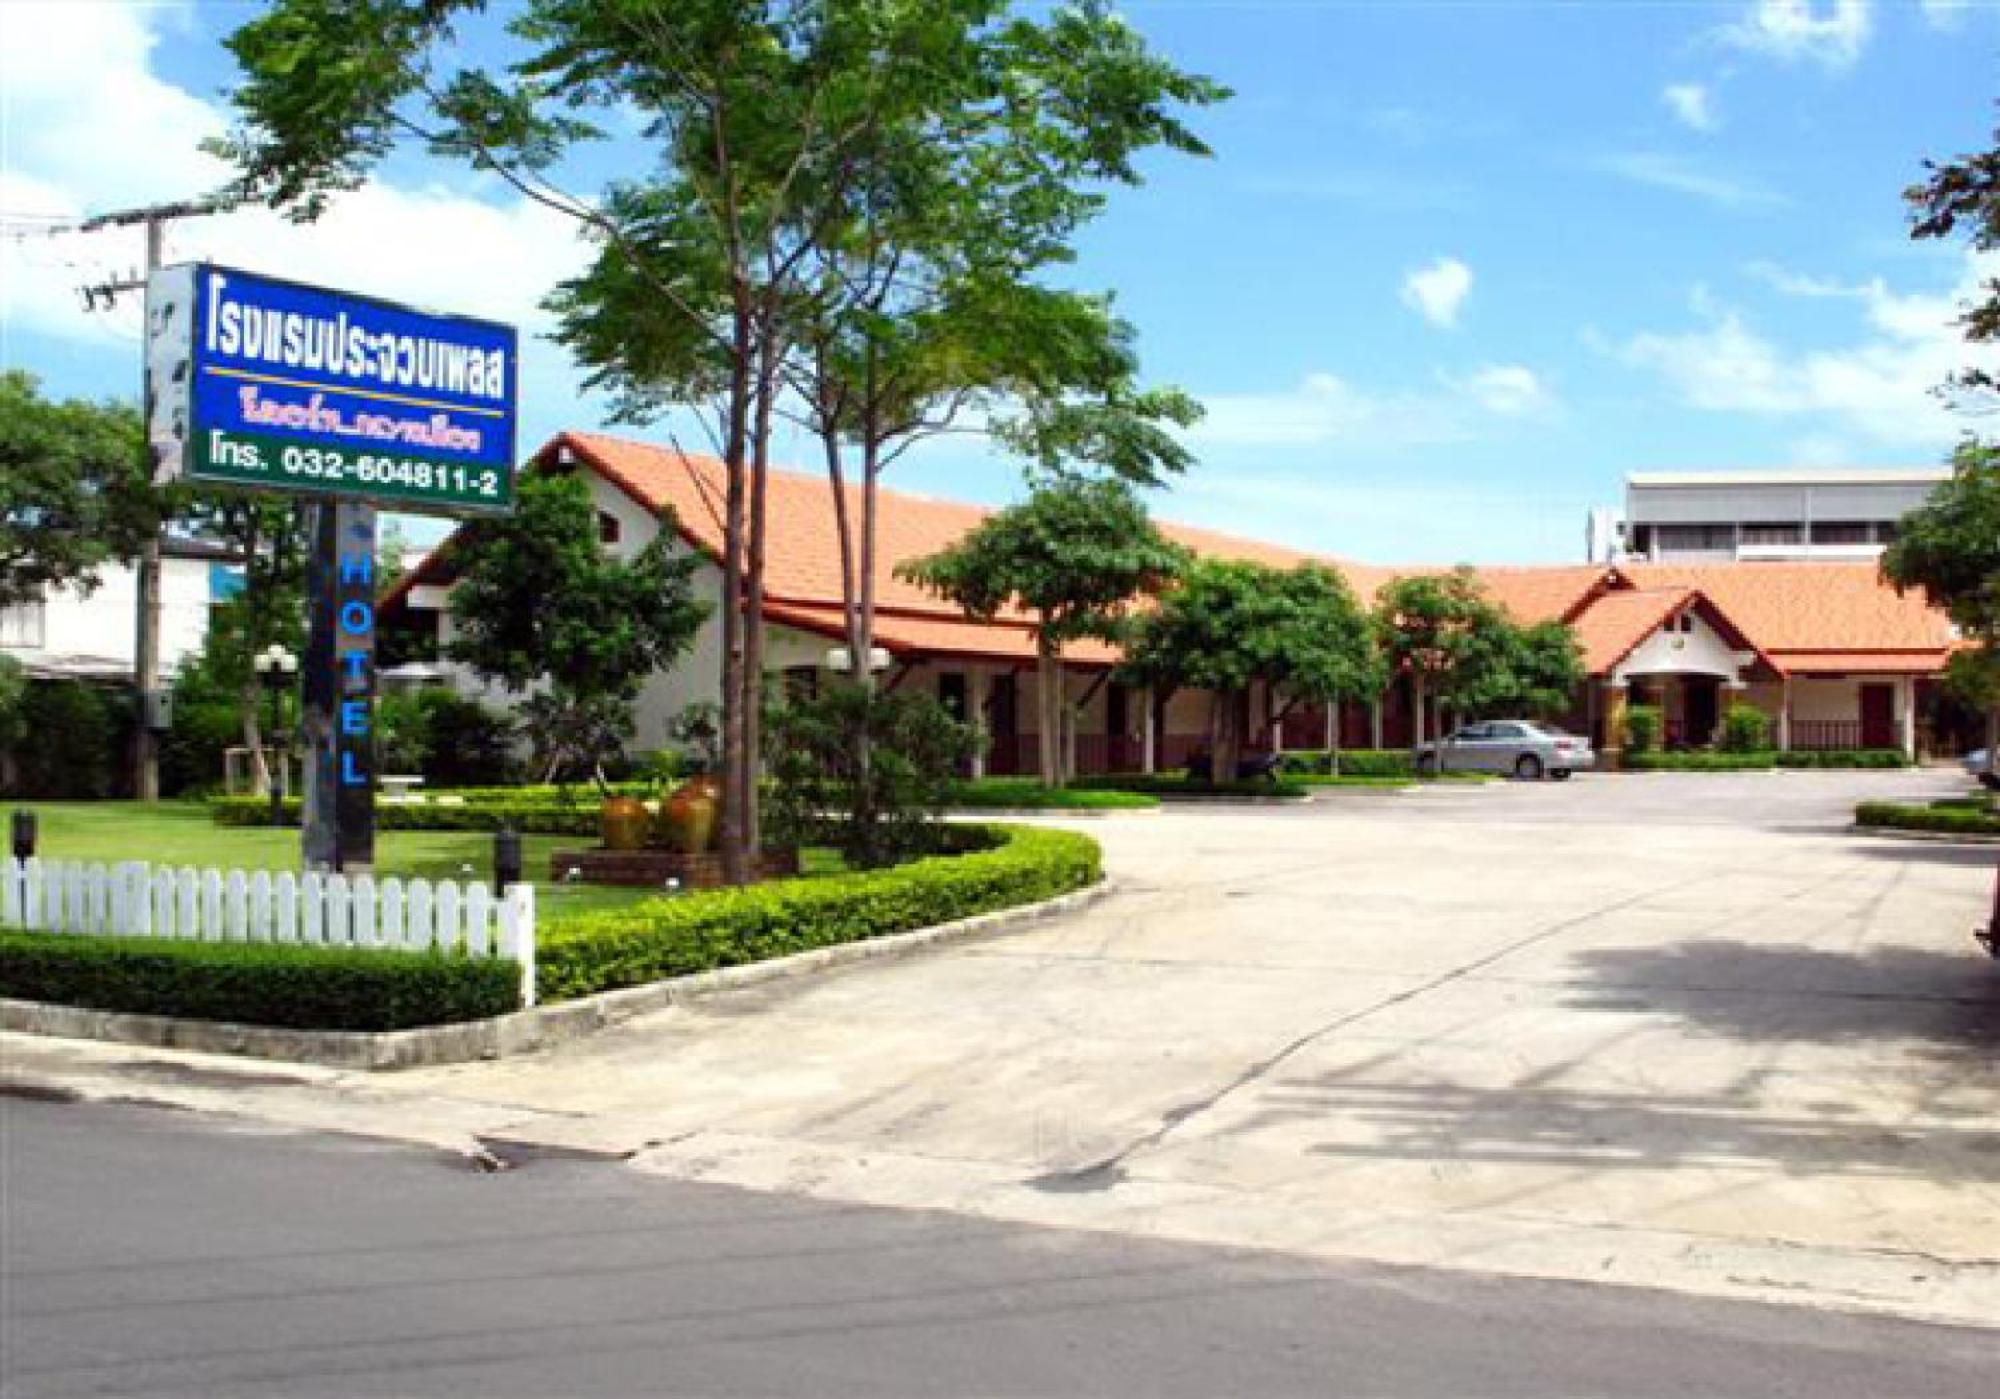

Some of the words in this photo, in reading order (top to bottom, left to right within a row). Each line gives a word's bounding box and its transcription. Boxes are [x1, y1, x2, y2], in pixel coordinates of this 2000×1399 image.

[210, 428, 269, 470] โทร.
[281, 446, 499, 496] 032-604811-2
[340, 553, 373, 784] HOTEL
